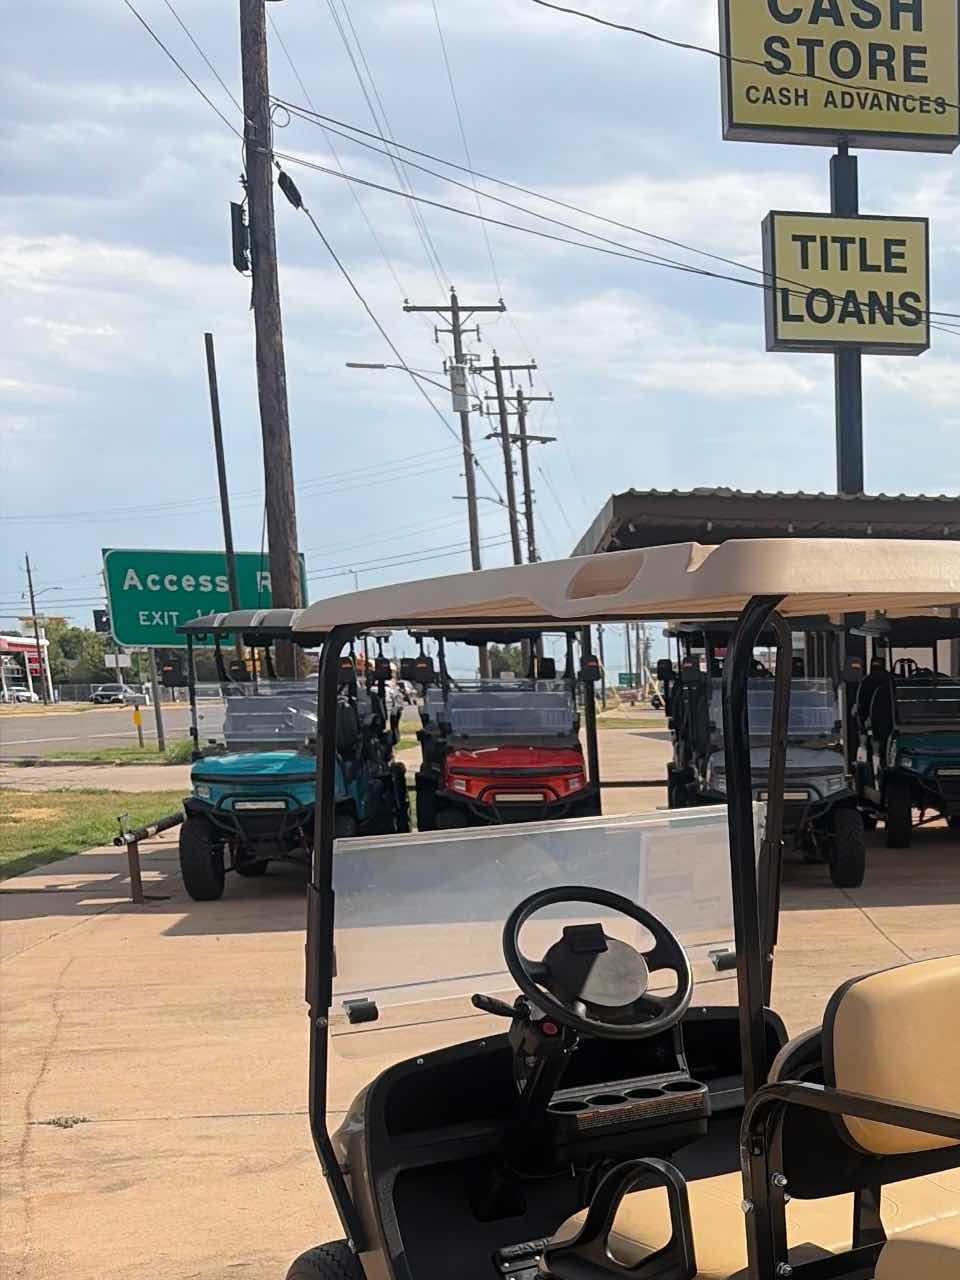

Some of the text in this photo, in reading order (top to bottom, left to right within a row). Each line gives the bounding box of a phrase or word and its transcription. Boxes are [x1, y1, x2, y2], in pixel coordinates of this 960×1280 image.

[767, 0, 924, 32] CASH
[763, 36, 929, 84] STORE
[745, 85, 947, 115] CASH ADVANCES
[791, 234, 908, 274] TITLE
[781, 287, 923, 327] LOANS
[122, 568, 230, 593] Access
[138, 611, 180, 626] EXIT
